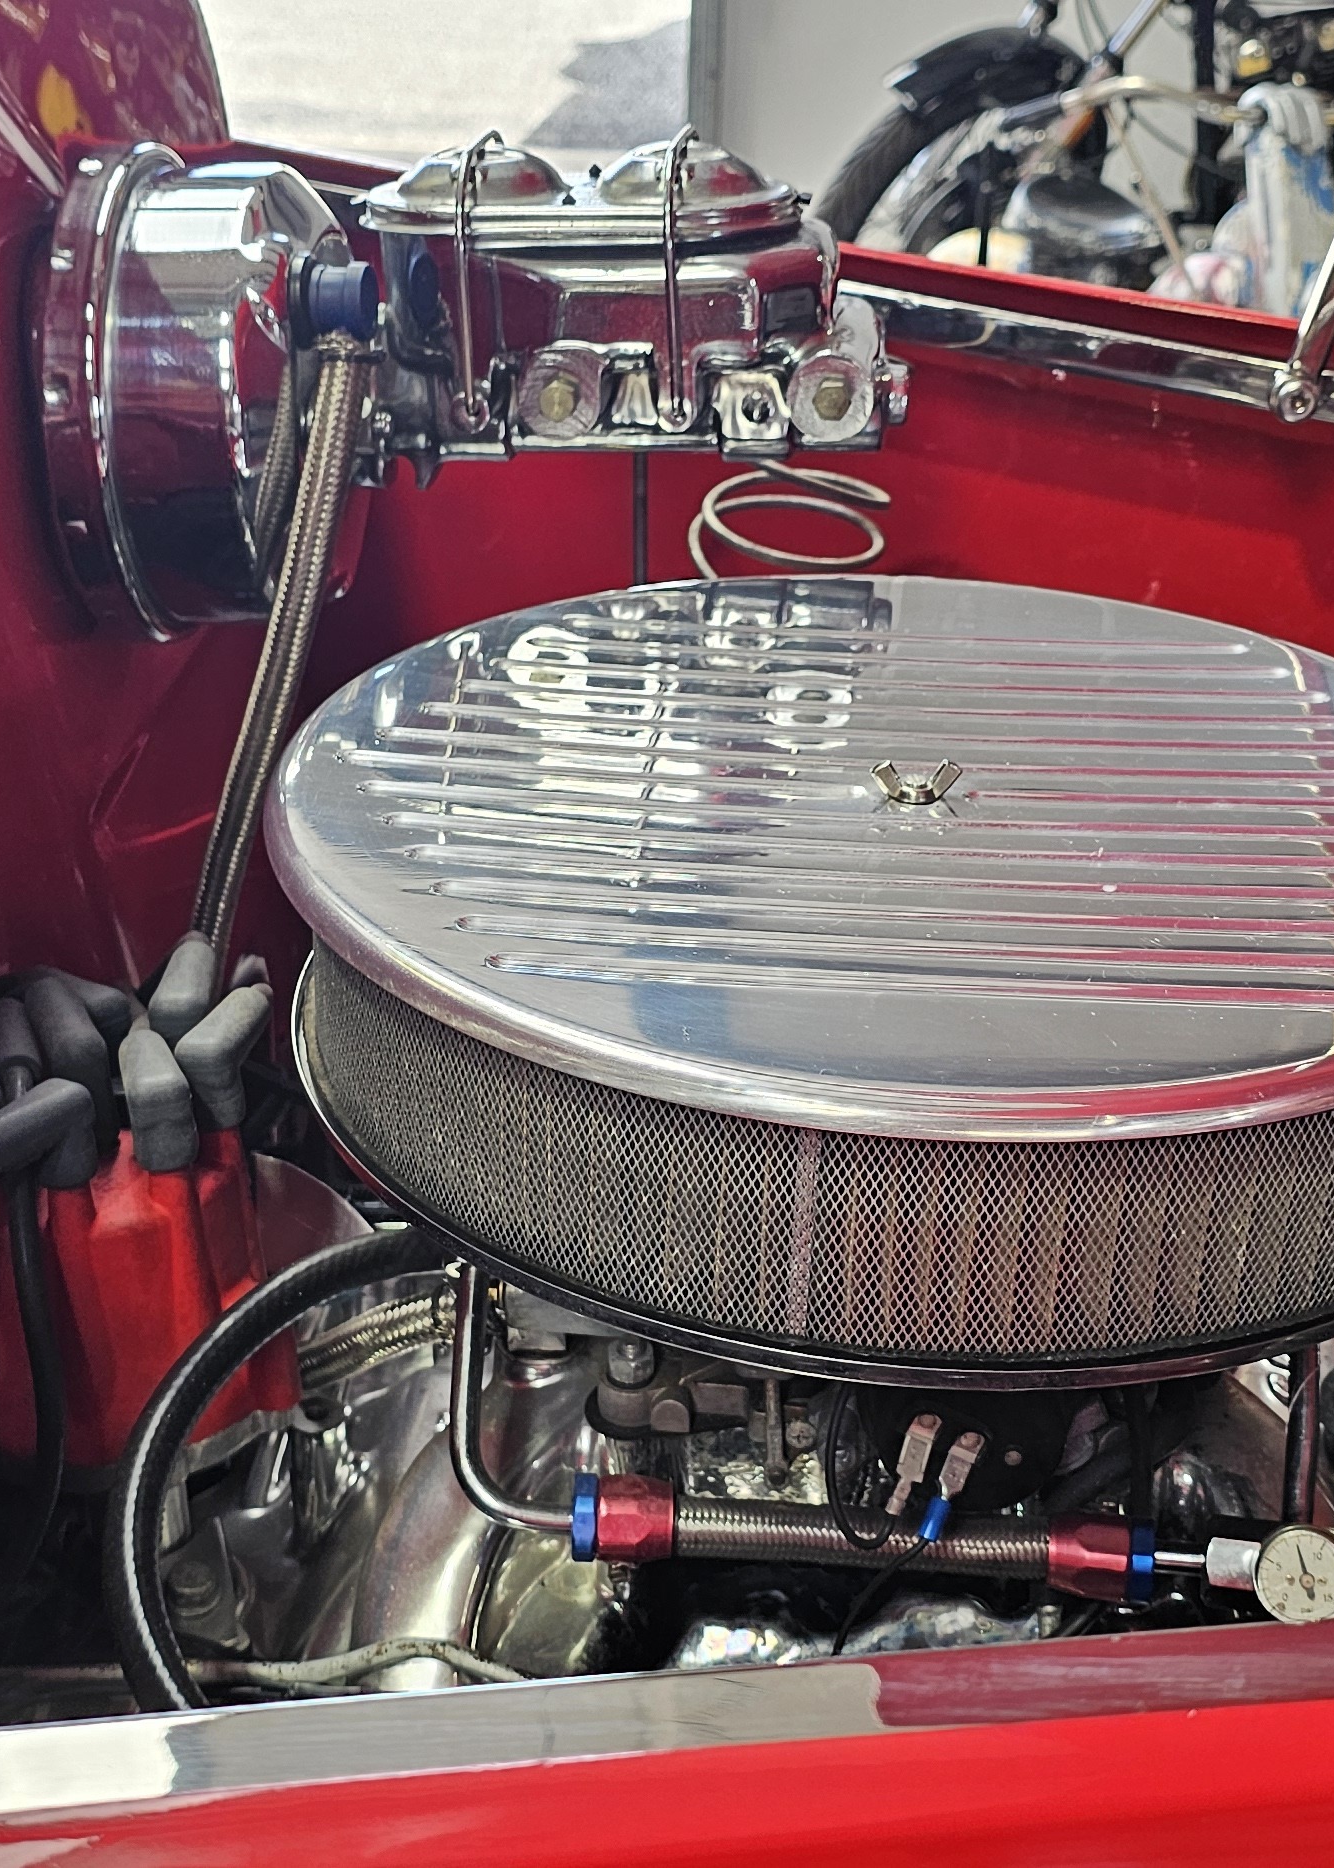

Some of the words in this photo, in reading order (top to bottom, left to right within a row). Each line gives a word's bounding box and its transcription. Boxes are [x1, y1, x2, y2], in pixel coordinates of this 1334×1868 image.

[1313, 1551, 1323, 1561] 10
[1275, 1561, 1282, 1571] 5
[1282, 1592, 1289, 1602] 0
[1323, 1593, 1333, 1602] 15
